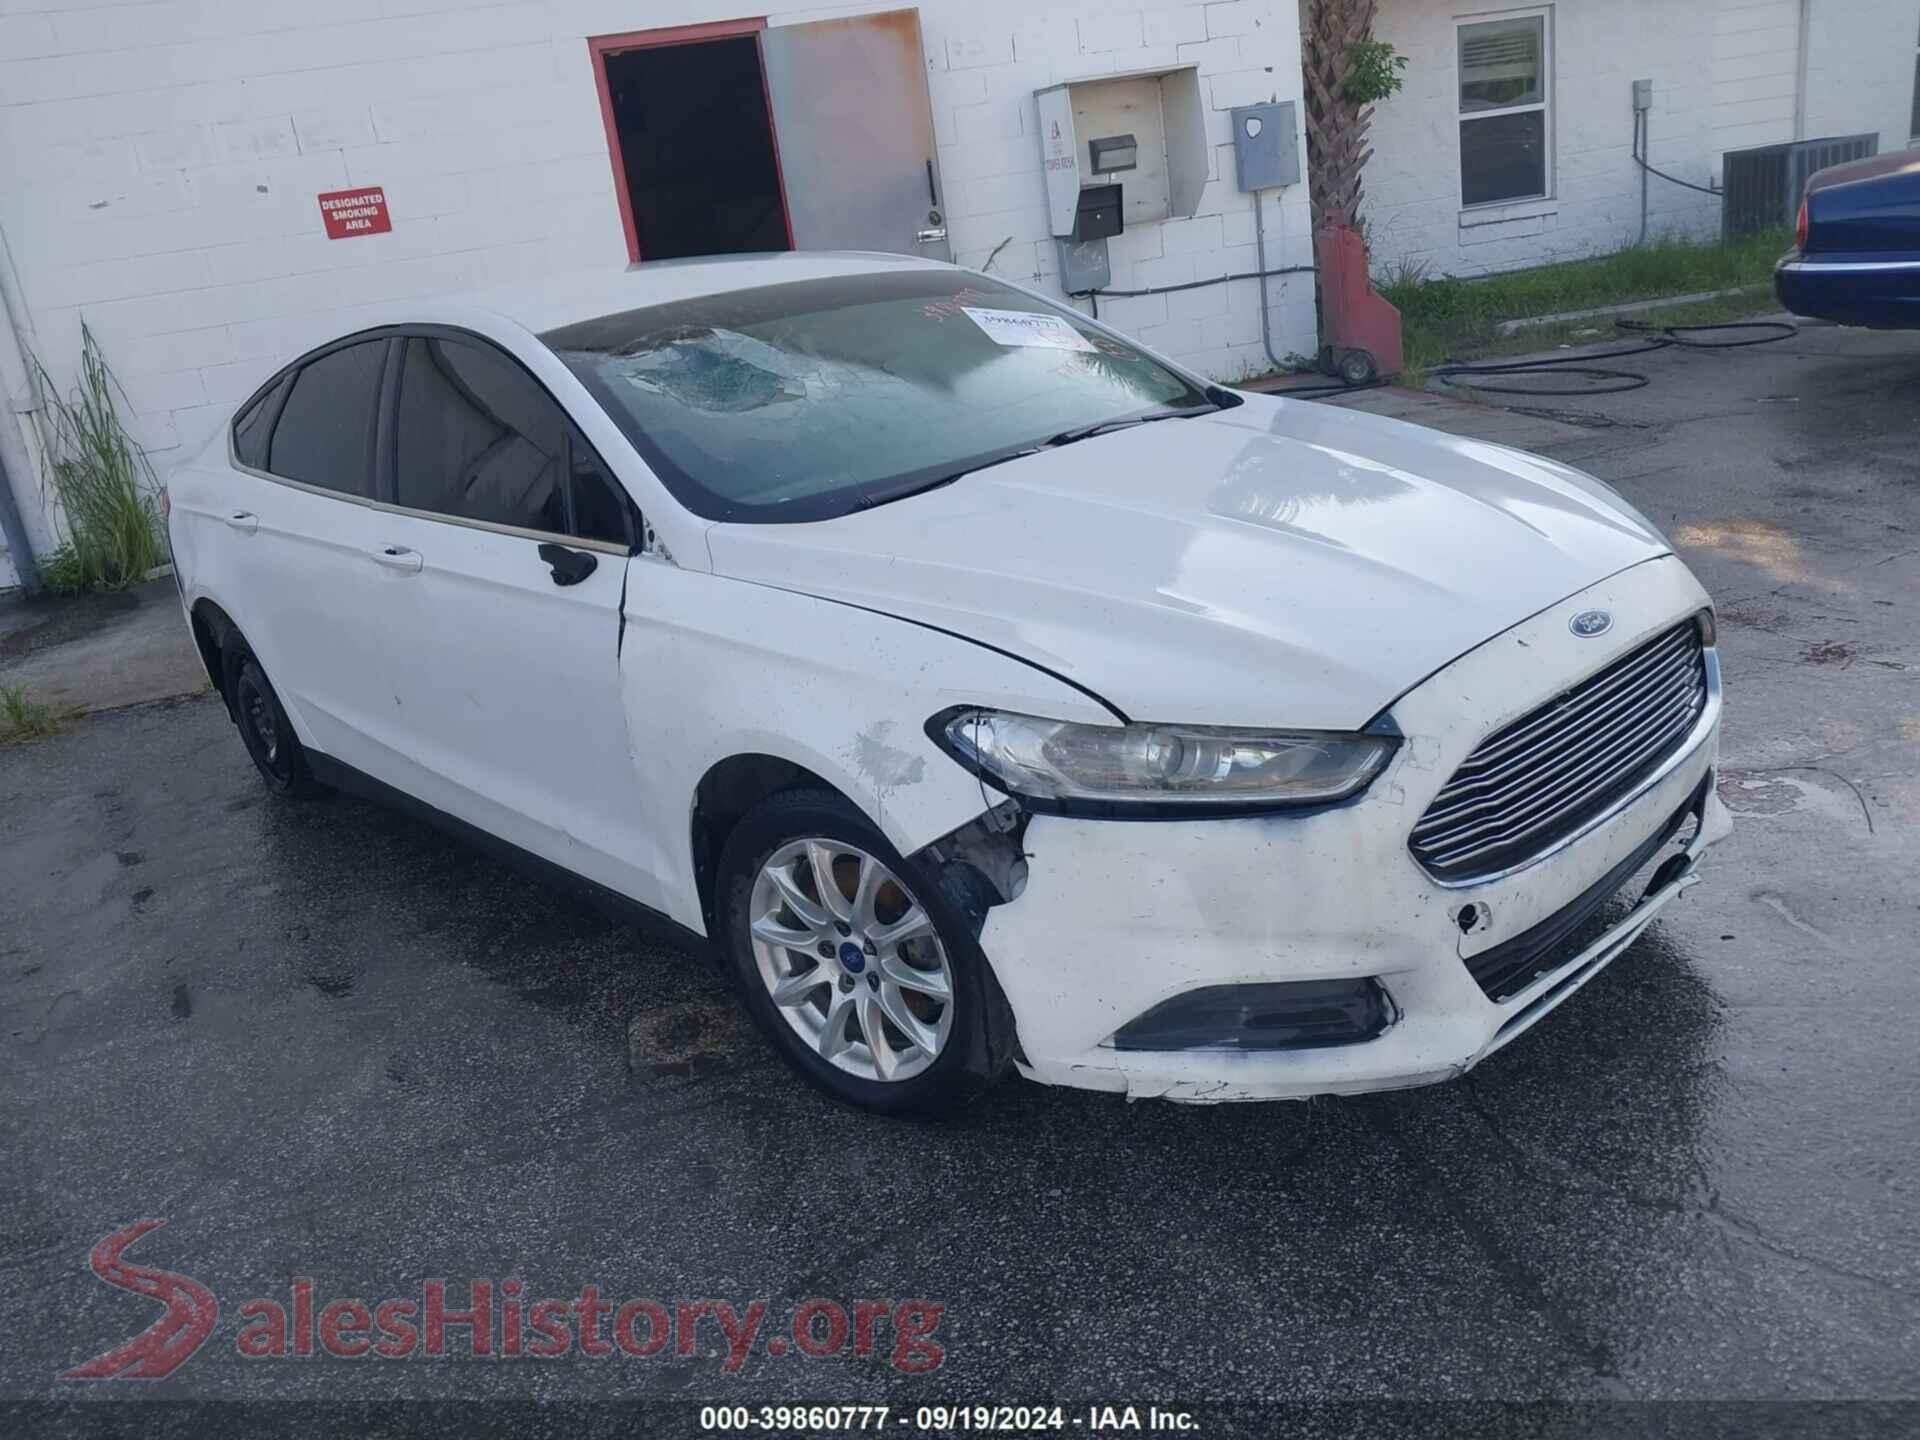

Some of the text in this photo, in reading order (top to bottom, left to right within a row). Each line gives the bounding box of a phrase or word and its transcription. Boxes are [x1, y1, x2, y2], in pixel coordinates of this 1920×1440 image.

[321, 194, 383, 210] DESIGNATED
[332, 206, 378, 220] SMOKING
[345, 219, 372, 230] AREA
